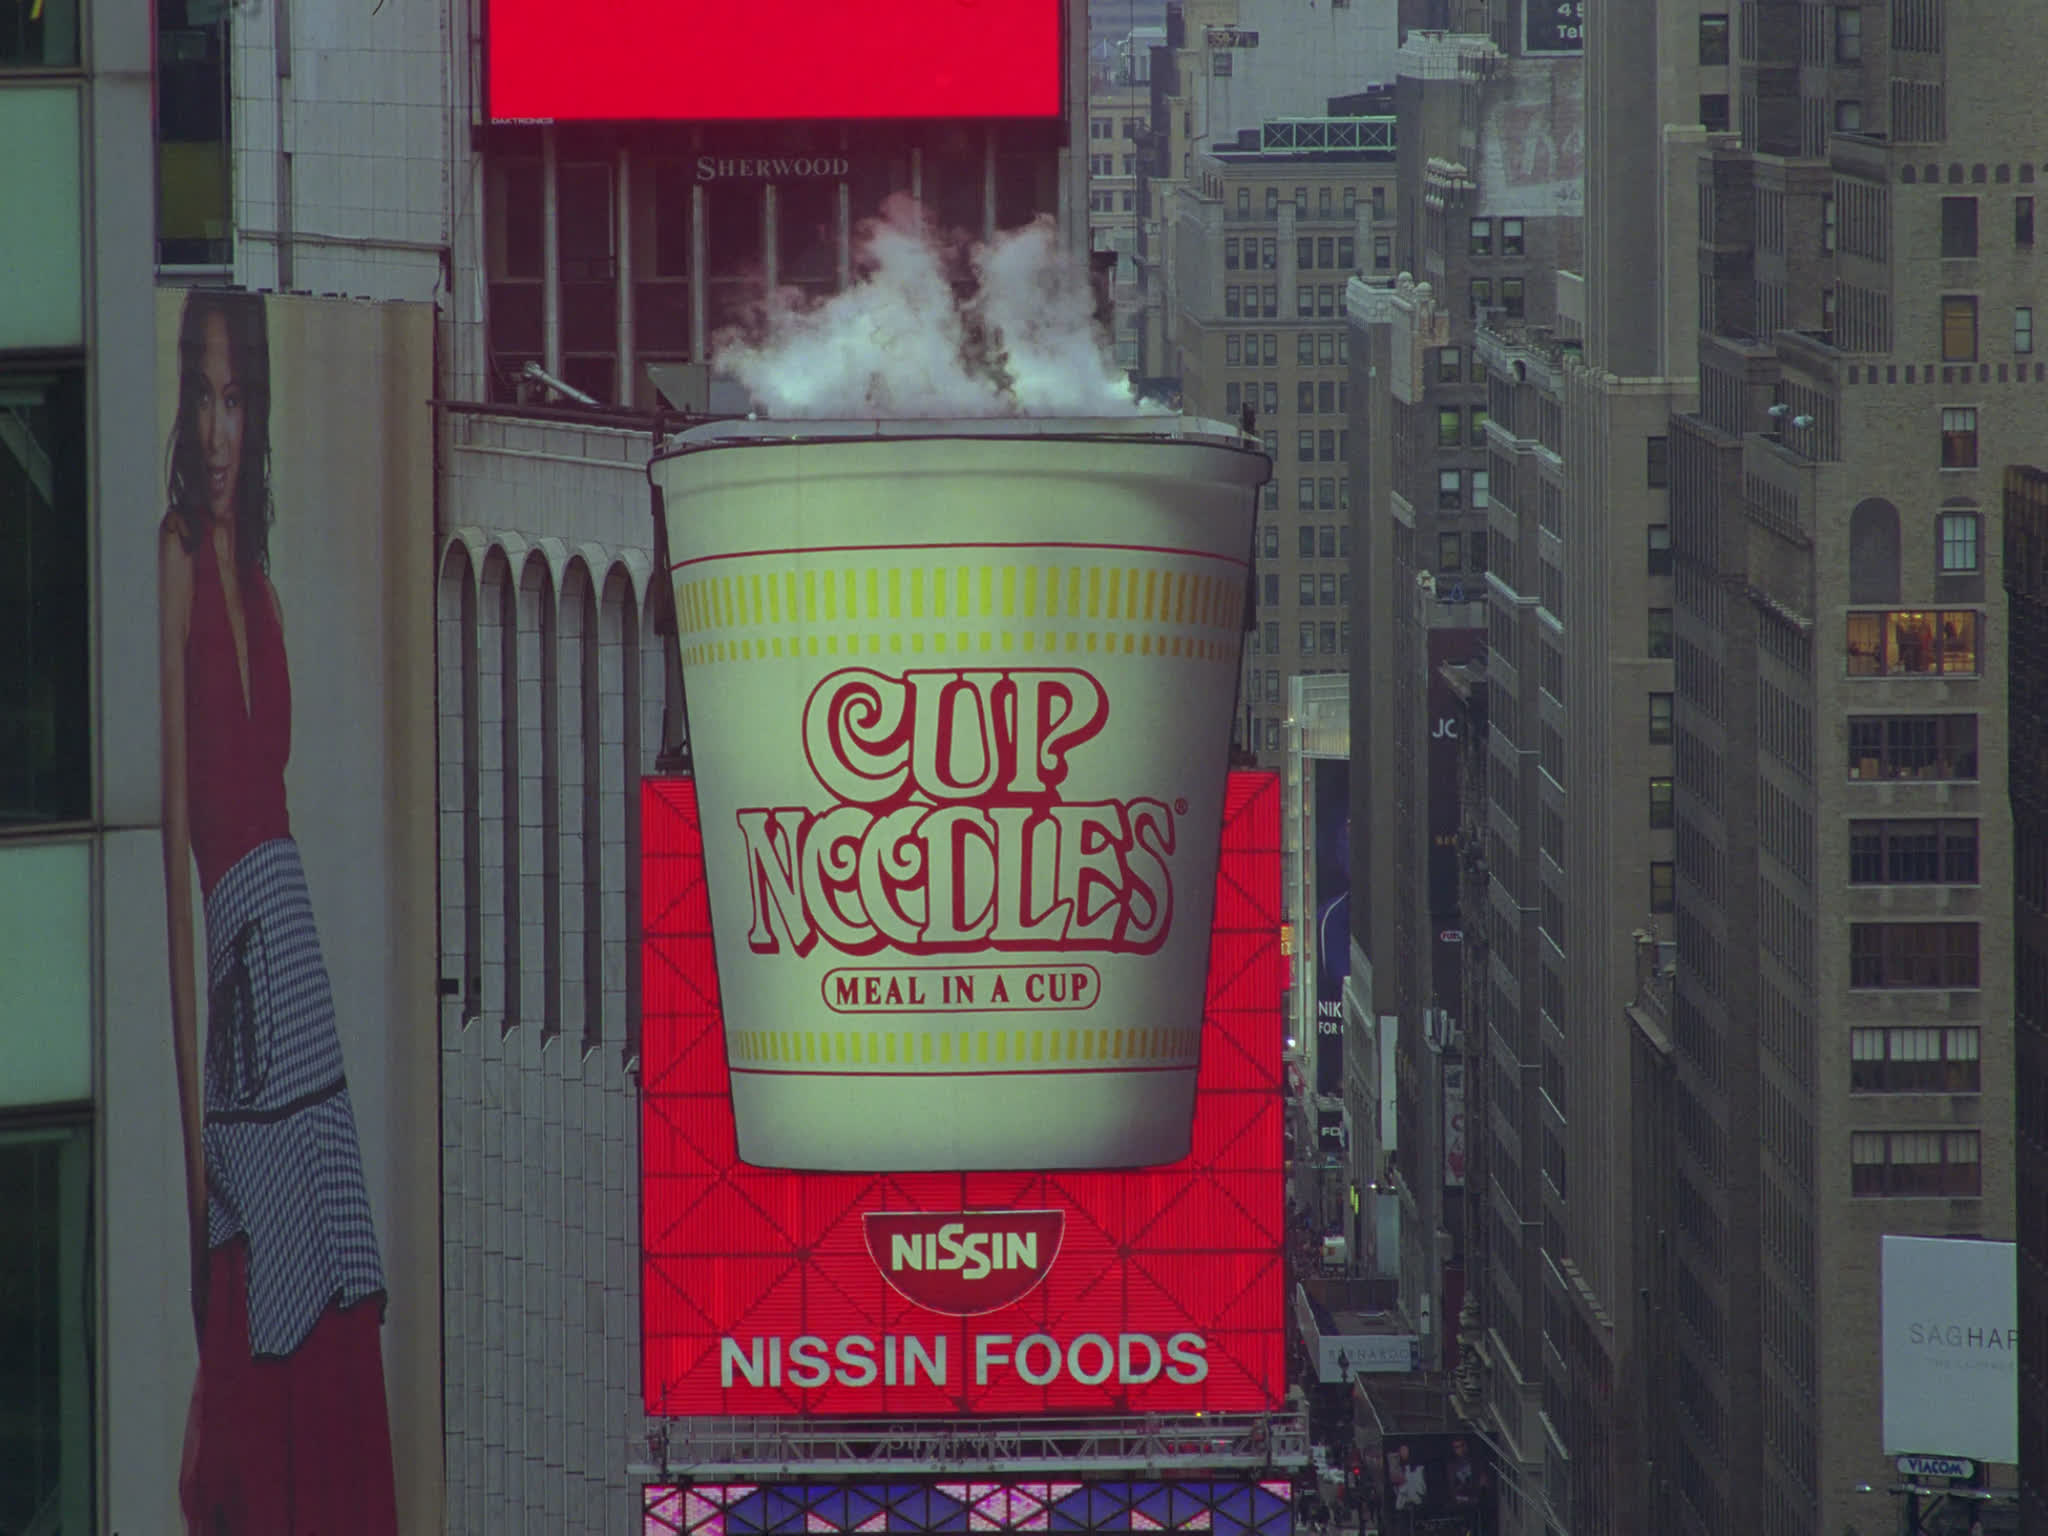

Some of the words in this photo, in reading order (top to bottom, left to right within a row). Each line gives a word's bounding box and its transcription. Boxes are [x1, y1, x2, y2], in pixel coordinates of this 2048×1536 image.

[696, 156, 849, 181] SHERWOOD
[802, 667, 1108, 803] CUP
[737, 798, 1176, 957] NOODLES
[836, 974, 925, 1006] MEAL
[942, 975, 974, 1004] IN
[990, 974, 1010, 1004] A
[1025, 972, 1089, 1004] CUP
[891, 1223, 1038, 1280] NISSIN
[719, 1334, 947, 1388] NISSIN
[975, 1332, 1210, 1386] FOODS
[1907, 1459, 1963, 1475] VIACOM
